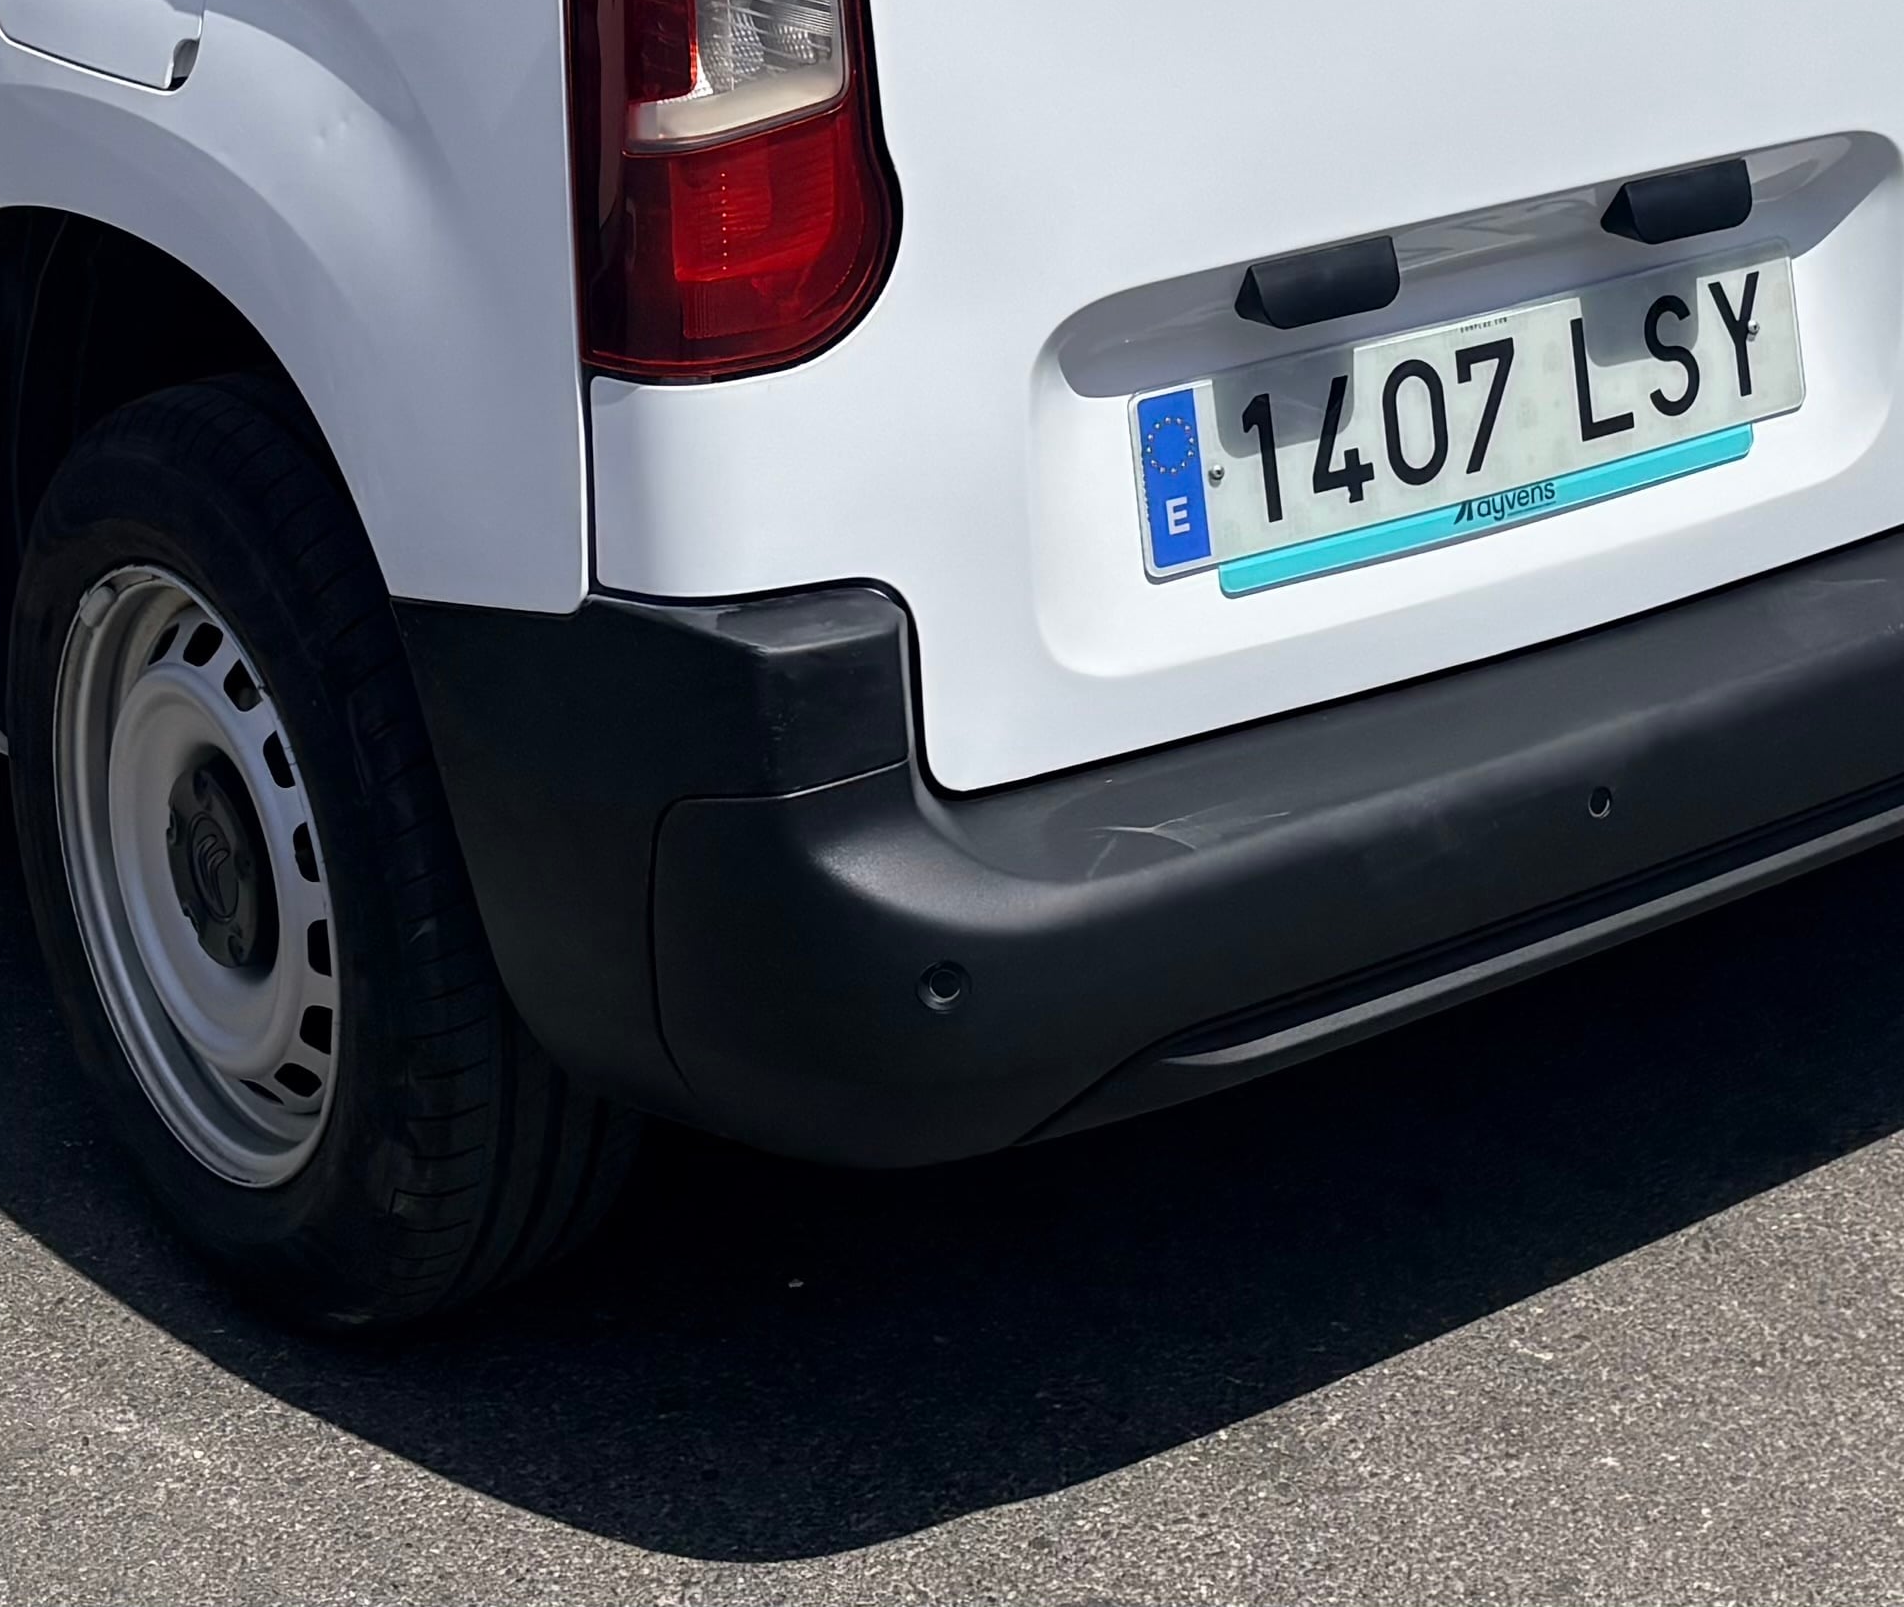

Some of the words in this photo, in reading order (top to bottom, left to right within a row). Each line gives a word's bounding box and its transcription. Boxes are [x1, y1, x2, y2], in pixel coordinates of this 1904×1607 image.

[1241, 337, 1516, 524] 1407
[1570, 272, 1761, 442] LSY
[1165, 496, 1191, 535] E
[1477, 482, 1555, 521] ayvens
